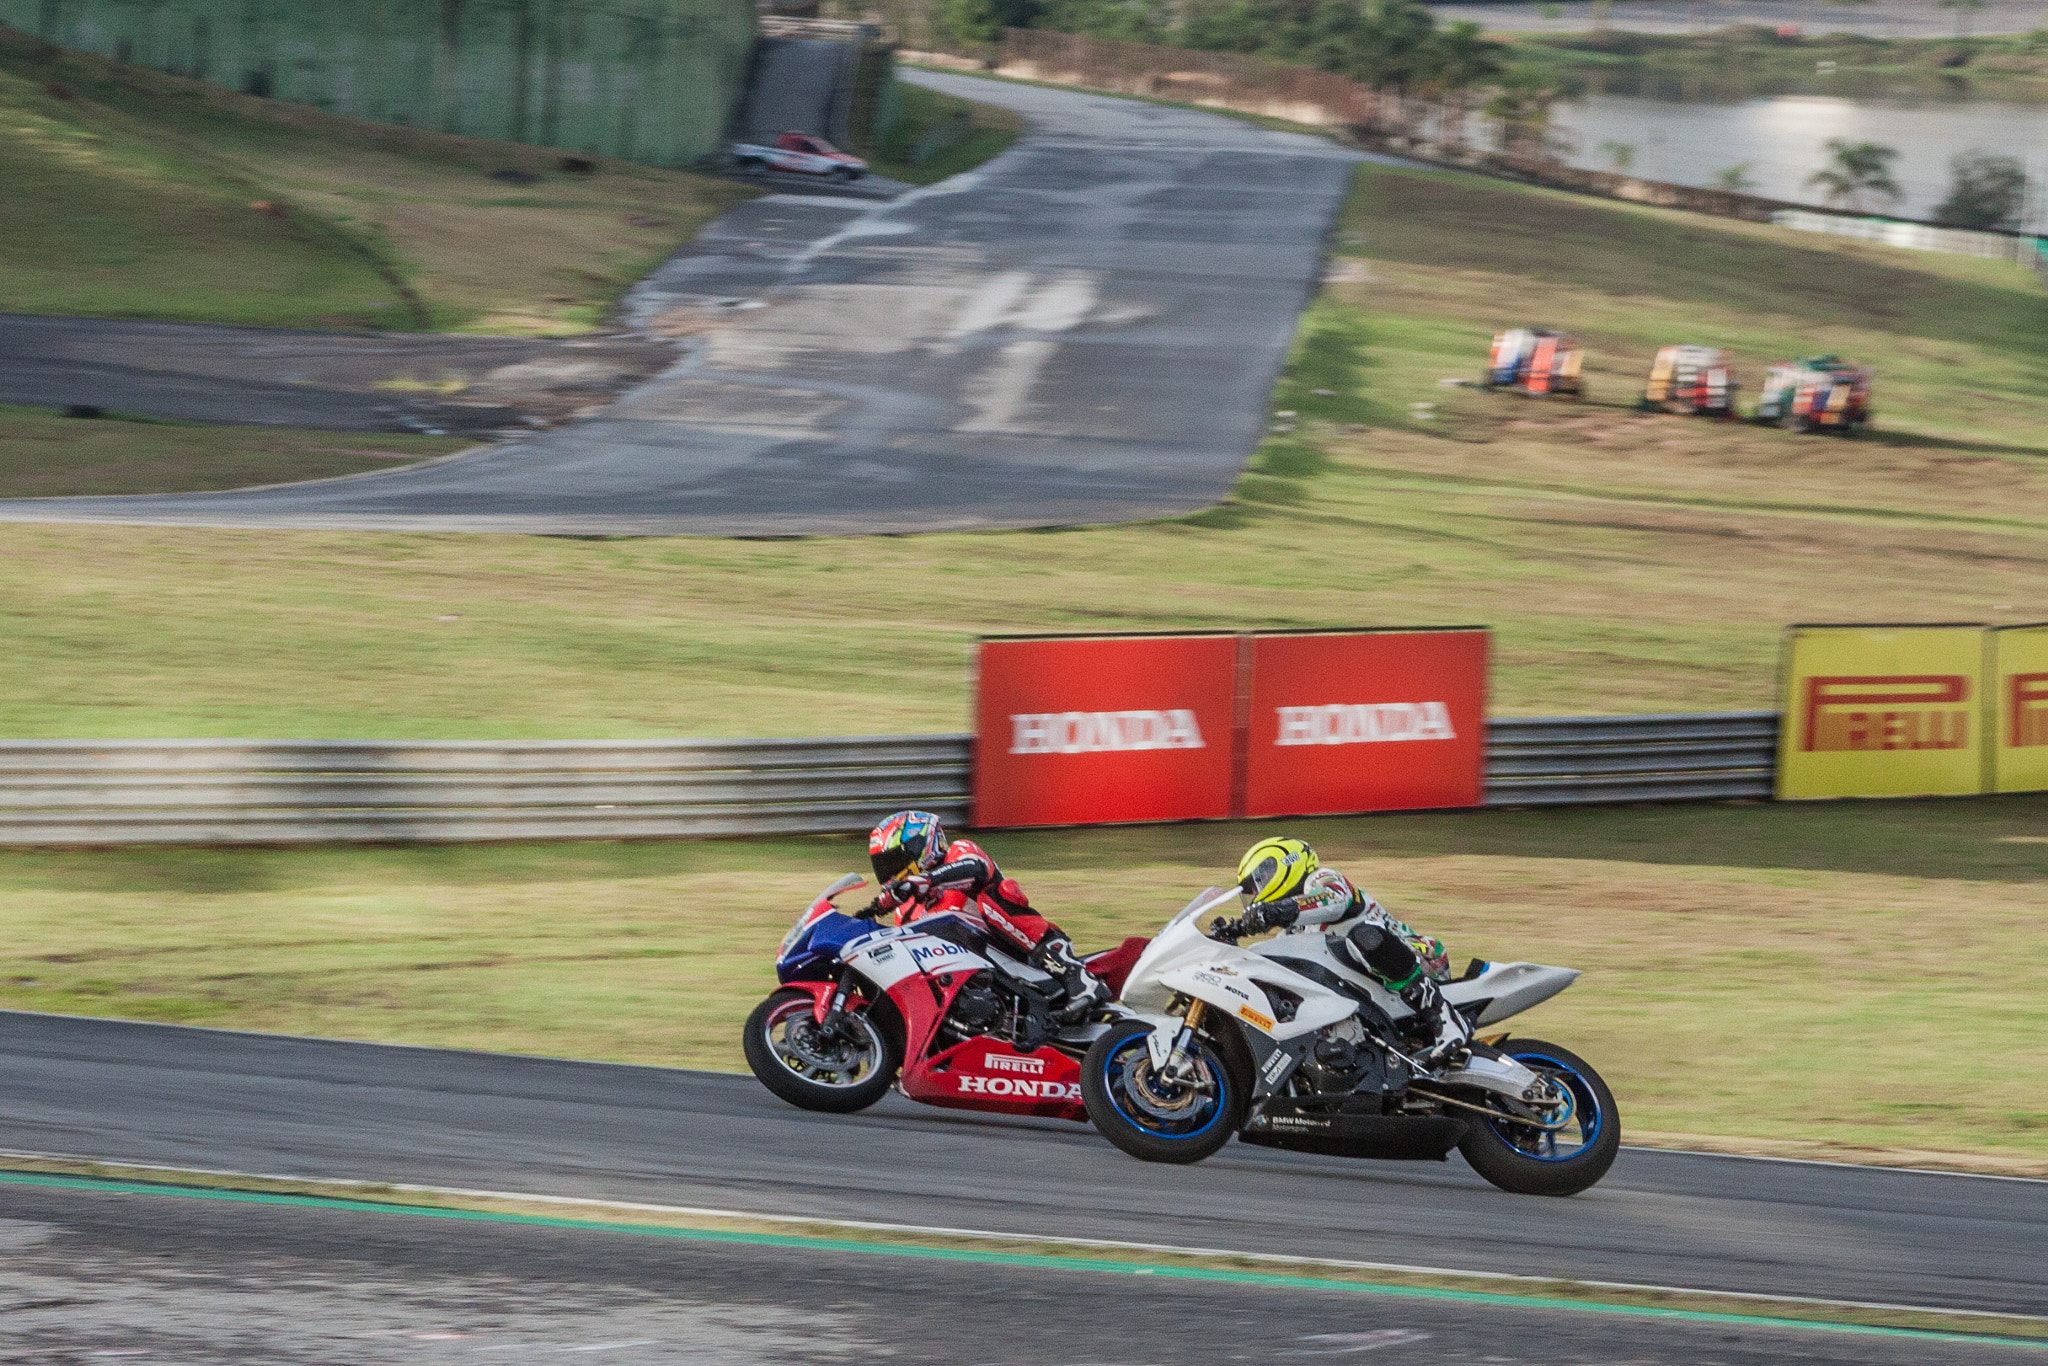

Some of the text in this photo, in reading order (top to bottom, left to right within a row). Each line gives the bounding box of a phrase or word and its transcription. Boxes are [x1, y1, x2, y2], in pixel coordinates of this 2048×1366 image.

[1009, 708, 1206, 754] HONDA
[1274, 701, 1456, 746] HONDA
[1225, 985, 1249, 1000] MOTUL
[984, 1053, 1044, 1074] PIRELLI
[958, 1075, 1082, 1099] HONDA
[1272, 1116, 1294, 1125] BMW
